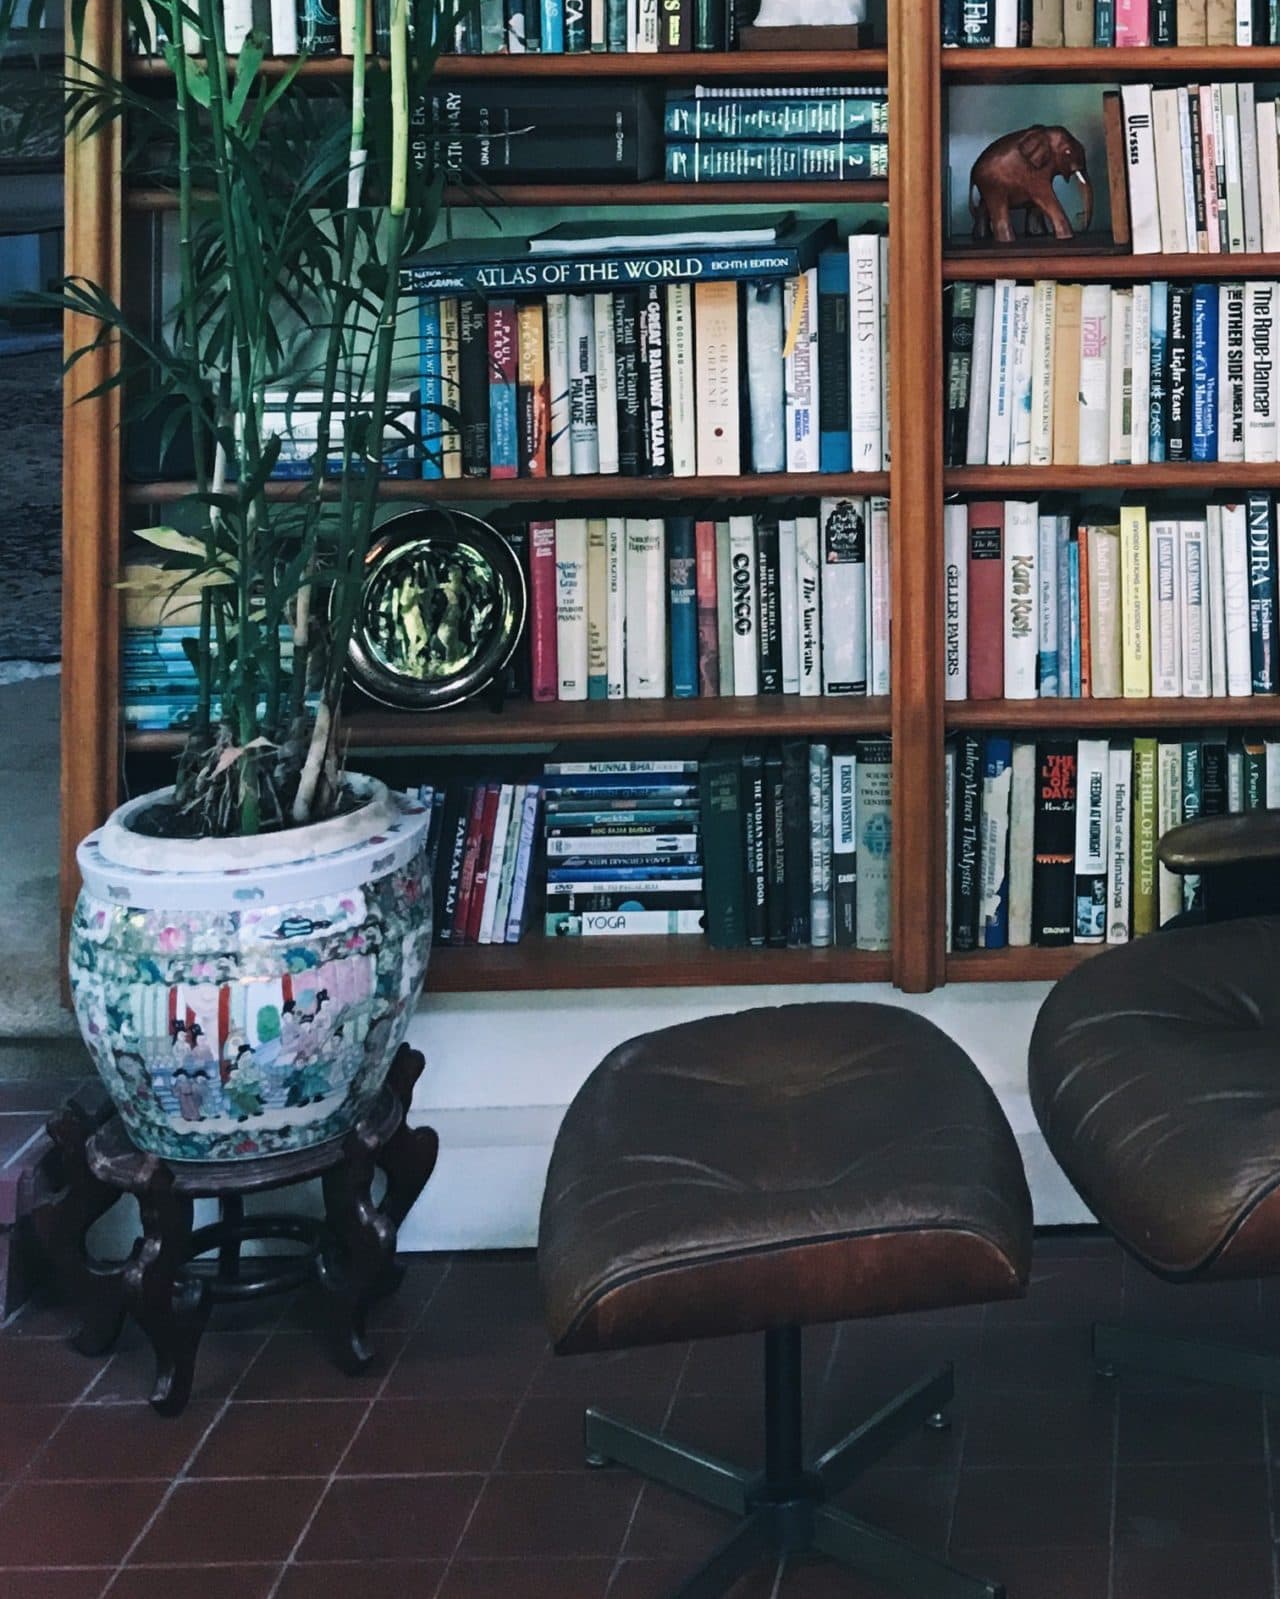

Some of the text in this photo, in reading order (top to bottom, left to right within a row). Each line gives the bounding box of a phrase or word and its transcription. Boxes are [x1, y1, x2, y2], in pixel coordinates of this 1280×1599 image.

[963, 1, 989, 35] File
[477, 255, 792, 287] ATLAS OF THE WORLD EIGHTH EDITION
[857, 257, 875, 342] BEATLES
[502, 325, 511, 363] PAUL
[616, 298, 626, 344] Theroux
[624, 317, 635, 344] Paul
[648, 301, 662, 348] GREAT
[1082, 316, 1106, 358] india
[1227, 302, 1243, 347] OTHER
[1252, 287, 1272, 417] The Rope-Dancer
[580, 335, 589, 373] THEROUX
[616, 353, 627, 400] Arsenal
[625, 353, 639, 416] The Family
[650, 349, 664, 408] RAILWAY
[707, 344, 717, 407] GREENE
[720, 343, 729, 407] GRAHAM
[795, 340, 811, 406] CARTHAGE
[1227, 349, 1243, 382] SIDE
[571, 377, 583, 425] PALACE
[585, 375, 596, 426] PICTURE
[1152, 337, 1162, 437] IN TIME LIKE GLASS
[1232, 383, 1243, 411] JAMES
[652, 410, 665, 467] BAZAAR
[610, 531, 618, 593] LIVING TOGETHER
[1160, 539, 1171, 600] ASIAN DRAMA
[1250, 499, 1270, 587] INDIRA
[733, 552, 752, 636] CONGO
[760, 551, 769, 656] JUDICIAL TRADITION
[768, 568, 776, 641] THE AMERICAN
[947, 563, 959, 676] GELLER PAPERS
[1011, 554, 1034, 639] Kara Kush
[804, 576, 816, 676] The Americans
[841, 764, 852, 844] CRISIS INVESTING
[958, 736, 978, 896] Aubrey Menen The Mystics
[1090, 771, 1102, 858] FREEDOM AT MIDNIGHT
[1184, 749, 1199, 820] Watney Cliv
[594, 814, 635, 823] Cocktail
[754, 779, 764, 907] THE INDIAN STORY BOOK
[1113, 783, 1125, 909] Hindus of the Himalayas
[1142, 750, 1153, 895] THE HILL OF FLUTES
[445, 816, 467, 915] SARKAR RAJ
[587, 915, 626, 929] YOGA
